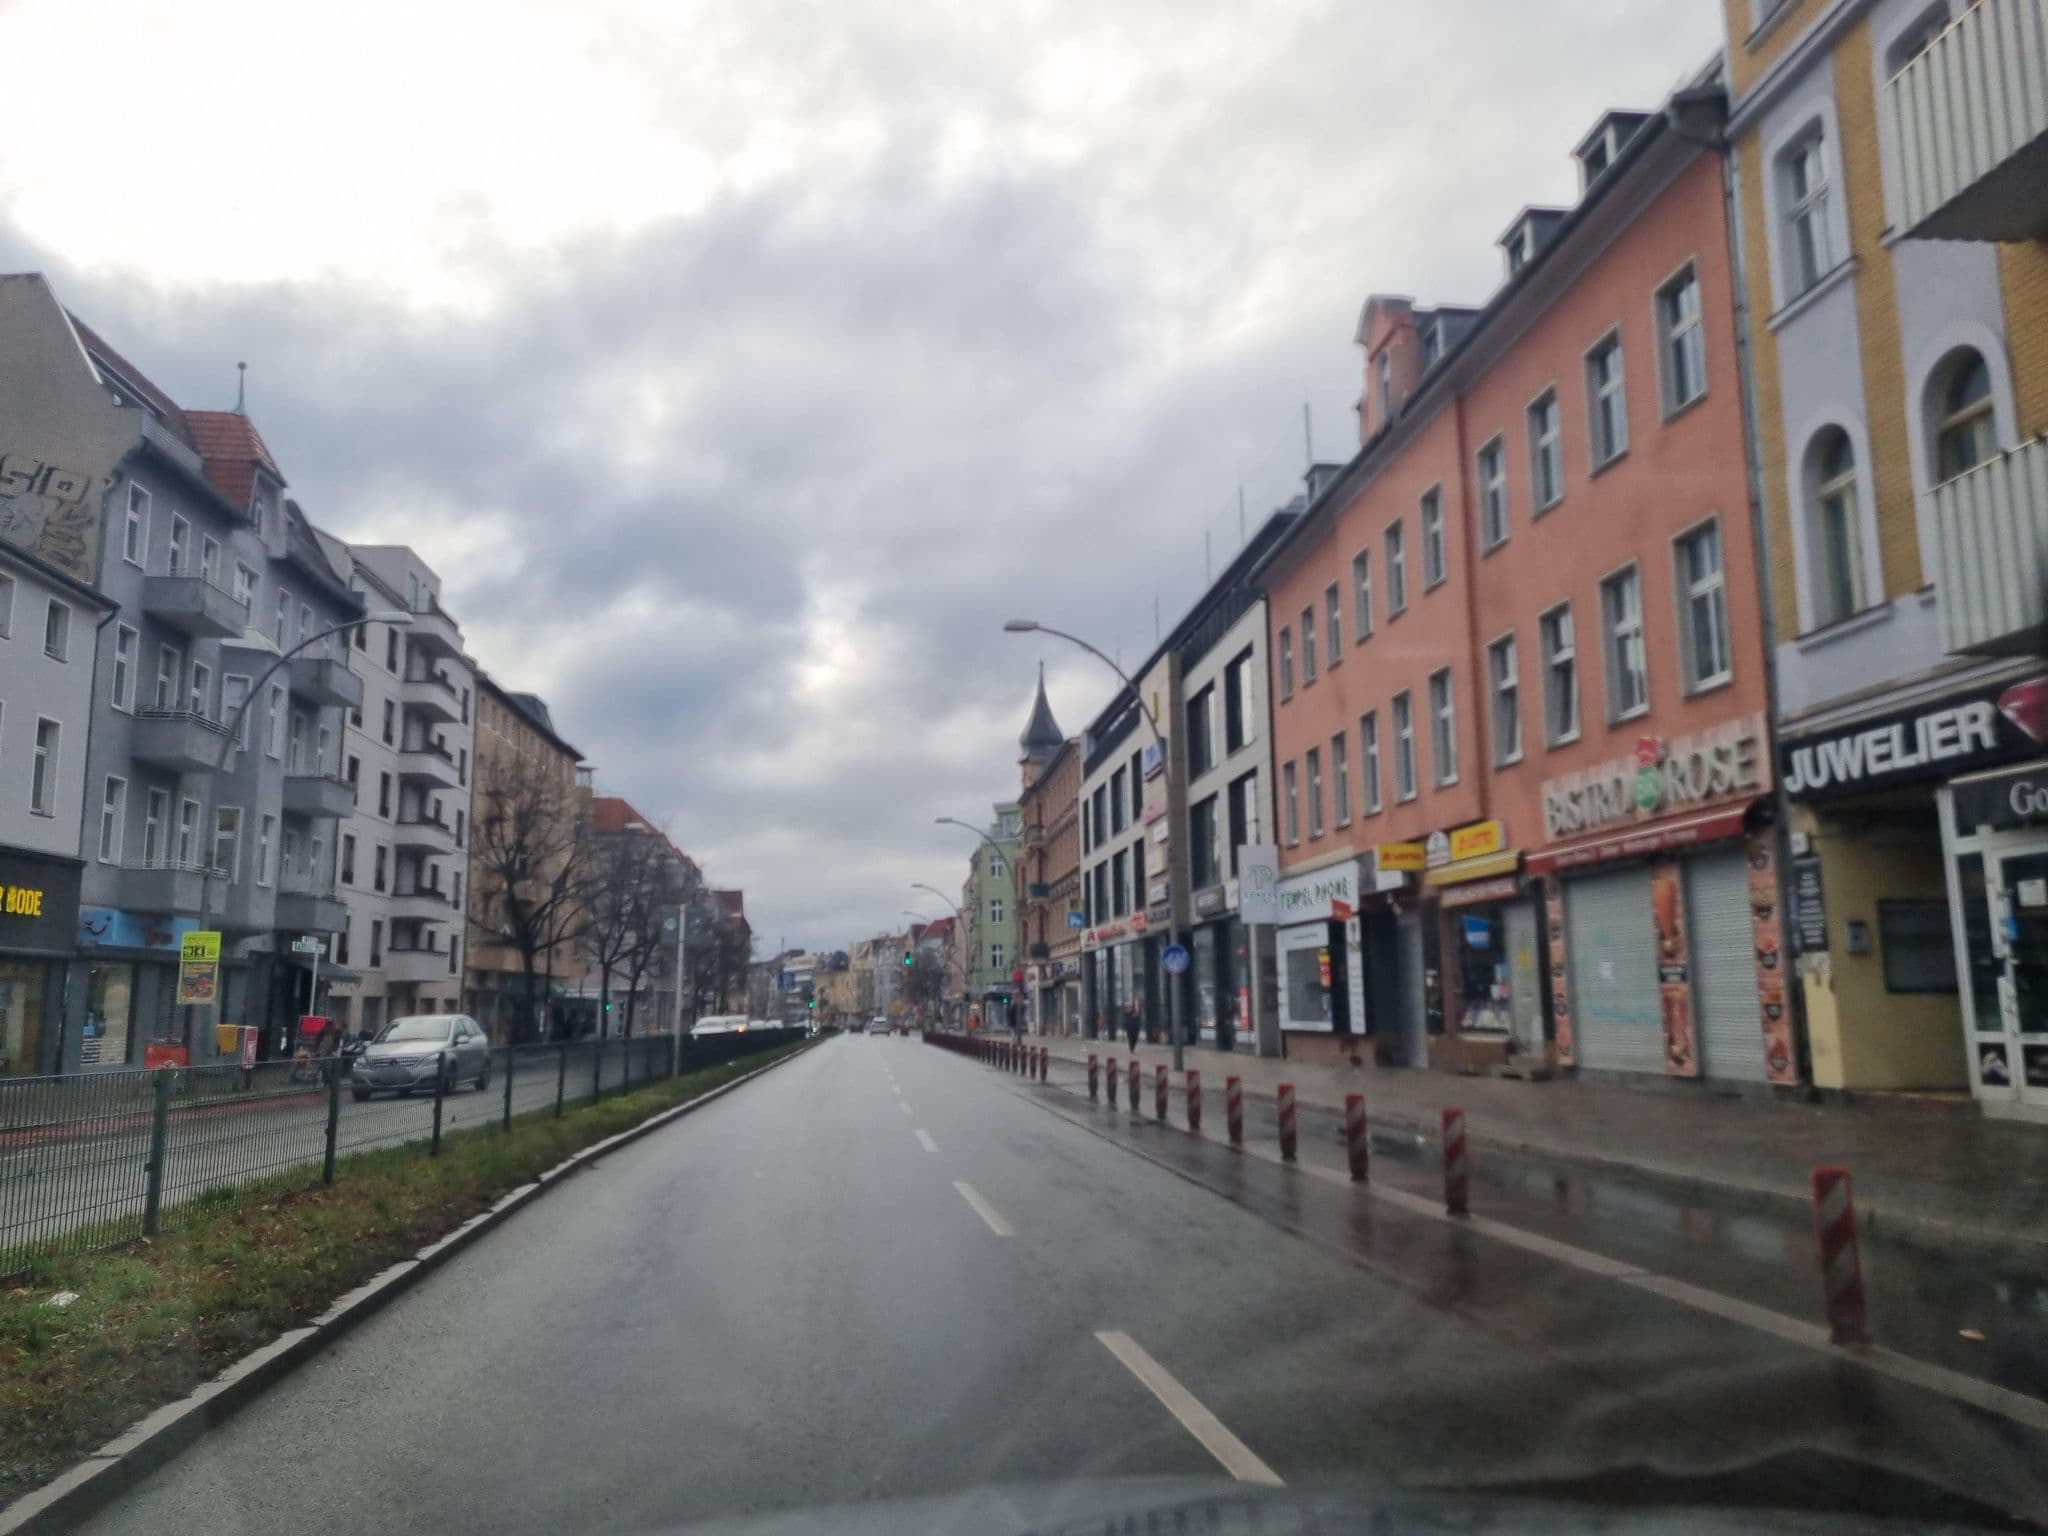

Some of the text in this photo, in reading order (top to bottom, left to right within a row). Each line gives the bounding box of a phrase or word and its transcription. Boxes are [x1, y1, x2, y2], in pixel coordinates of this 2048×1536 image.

[1546, 736, 1760, 836] BISTRO ROSE
[1783, 701, 1998, 794] JUWELIER
[6, 886, 43, 916] BODE
